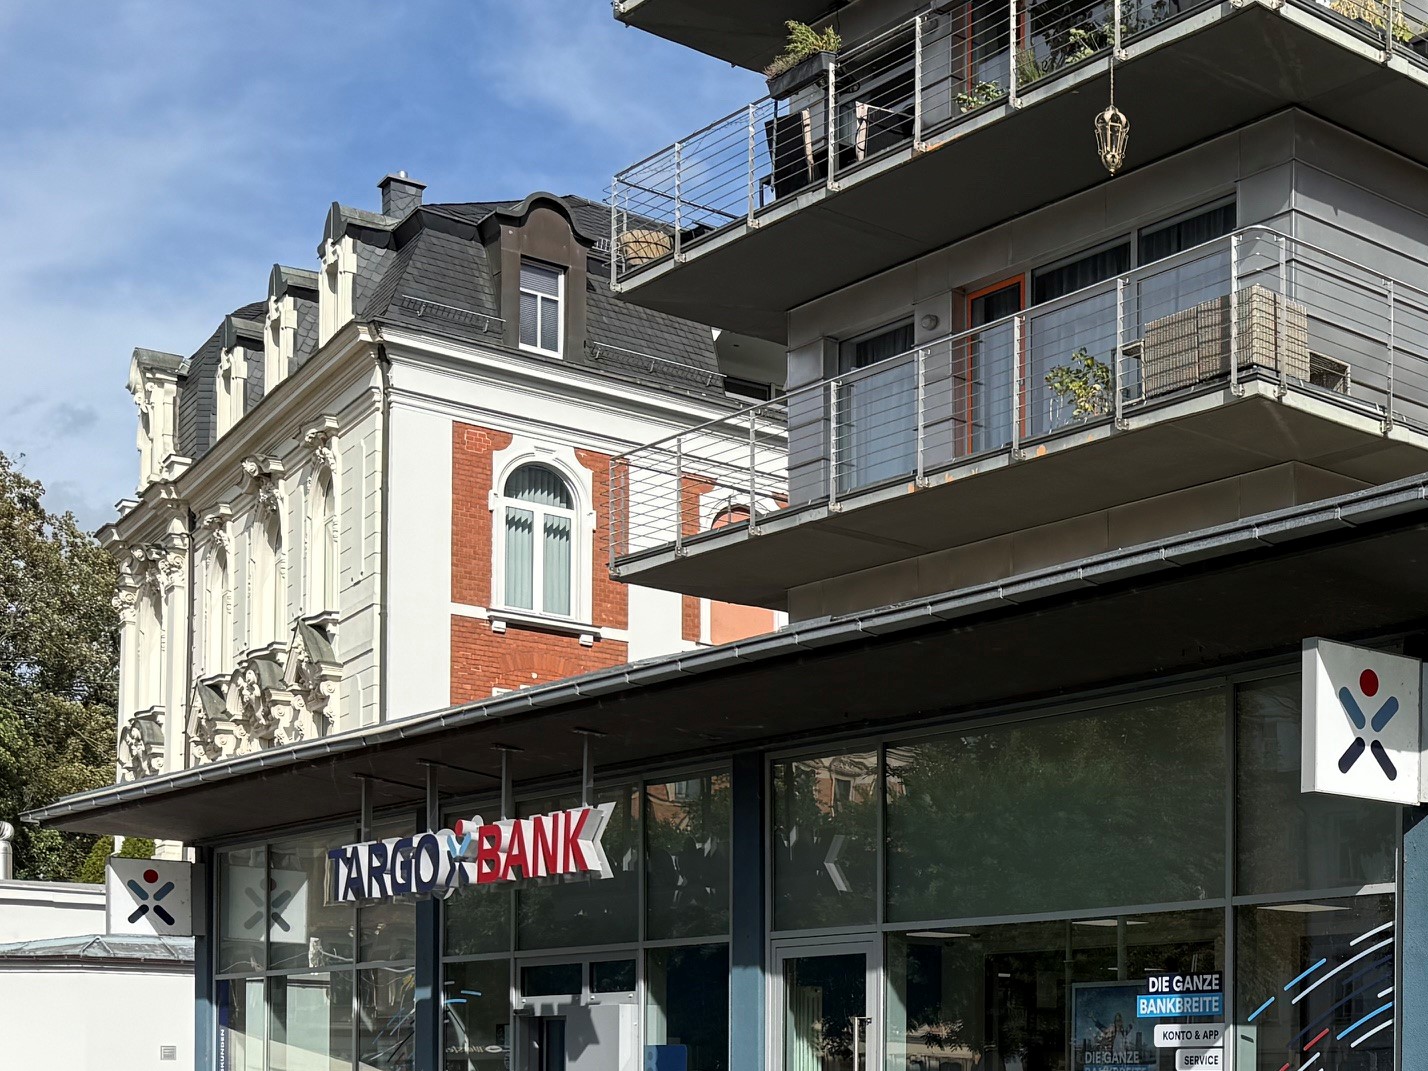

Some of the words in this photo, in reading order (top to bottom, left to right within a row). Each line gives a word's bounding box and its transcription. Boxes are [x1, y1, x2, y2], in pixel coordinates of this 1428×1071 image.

[327, 830, 440, 901] TARGO
[476, 806, 592, 884] BANK
[1148, 976, 1170, 993] DIE
[1172, 973, 1220, 992] GANZE
[1139, 995, 1220, 1015] BANKBREITE
[1162, 1030, 1193, 1041] KONTO
[1194, 1030, 1201, 1040] &
[1202, 1029, 1219, 1040] APP
[1084, 1051, 1100, 1064] DIE
[1103, 1051, 1140, 1064] GANZE
[1183, 1055, 1219, 1066] SERVICE
